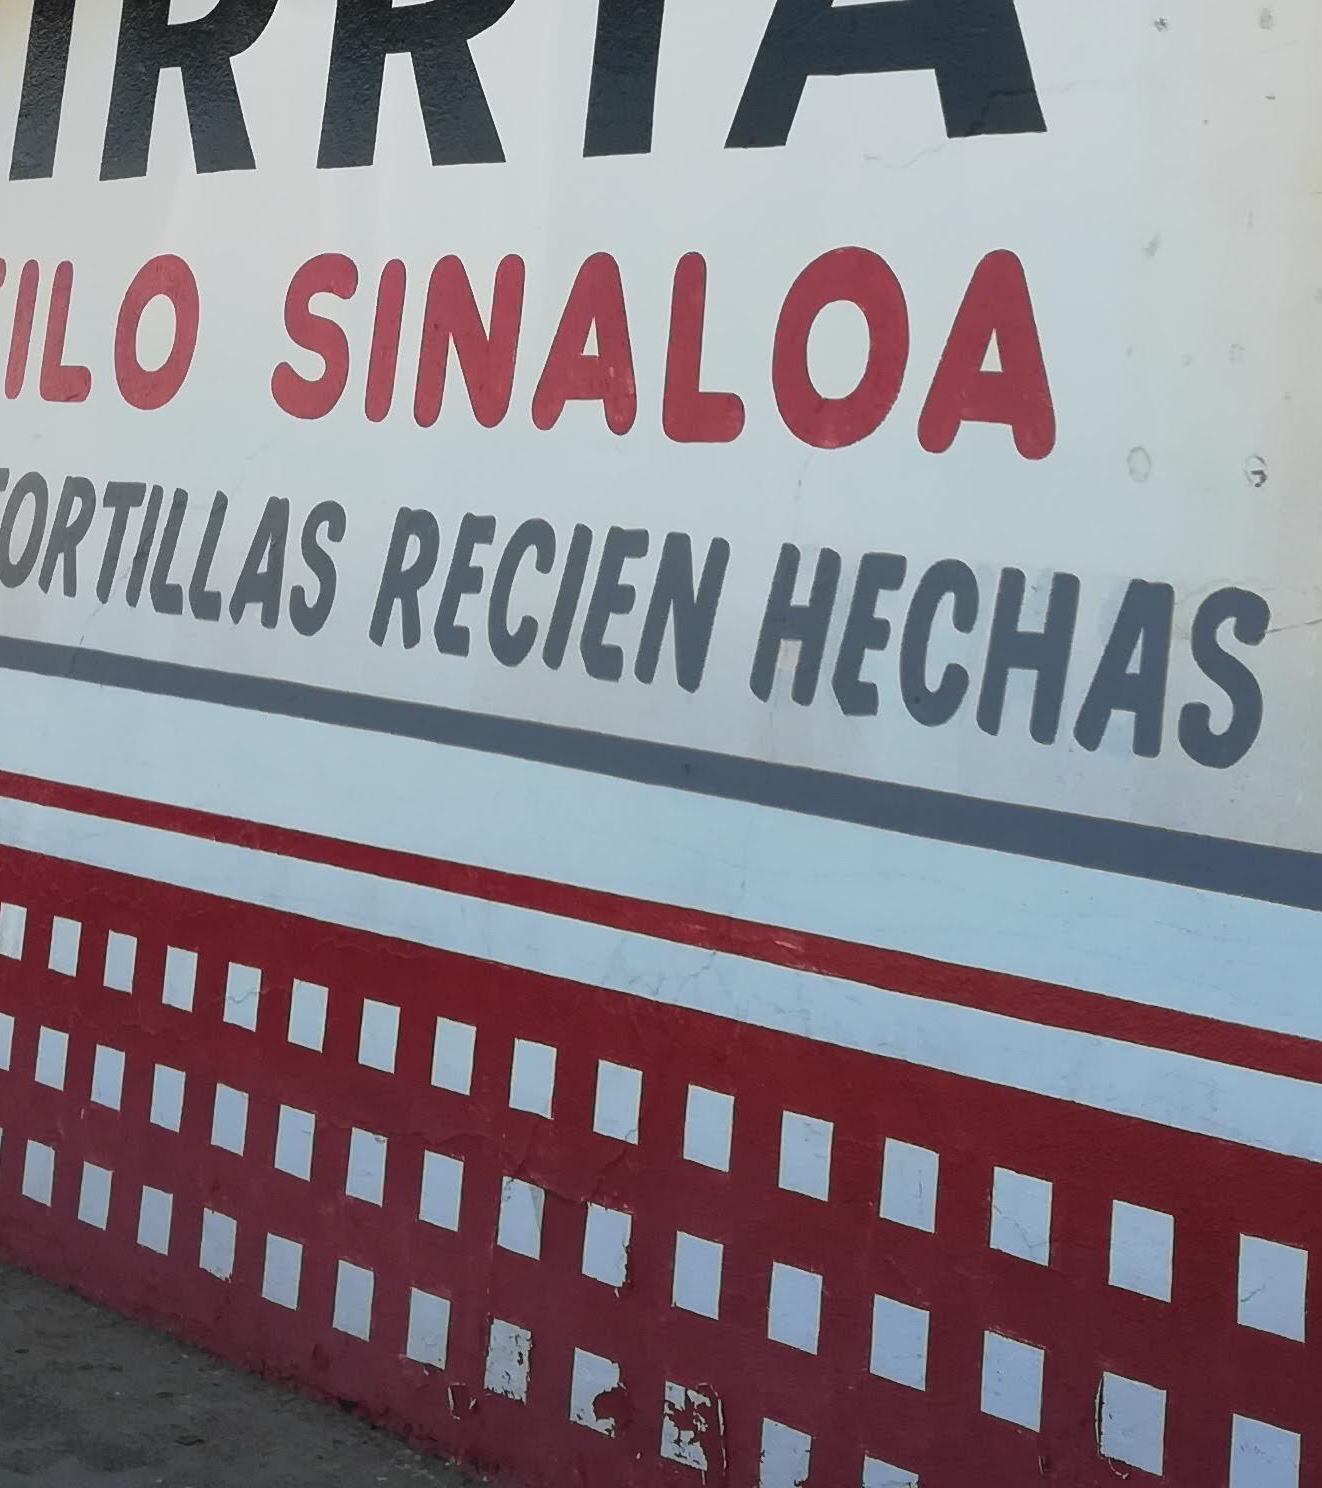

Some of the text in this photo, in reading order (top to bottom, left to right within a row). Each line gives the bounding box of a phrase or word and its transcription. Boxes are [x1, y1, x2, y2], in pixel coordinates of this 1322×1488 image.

[271, 245, 1057, 460] SINALOA
[366, 506, 731, 689] RECIEN
[748, 542, 1273, 771] HECHAS
